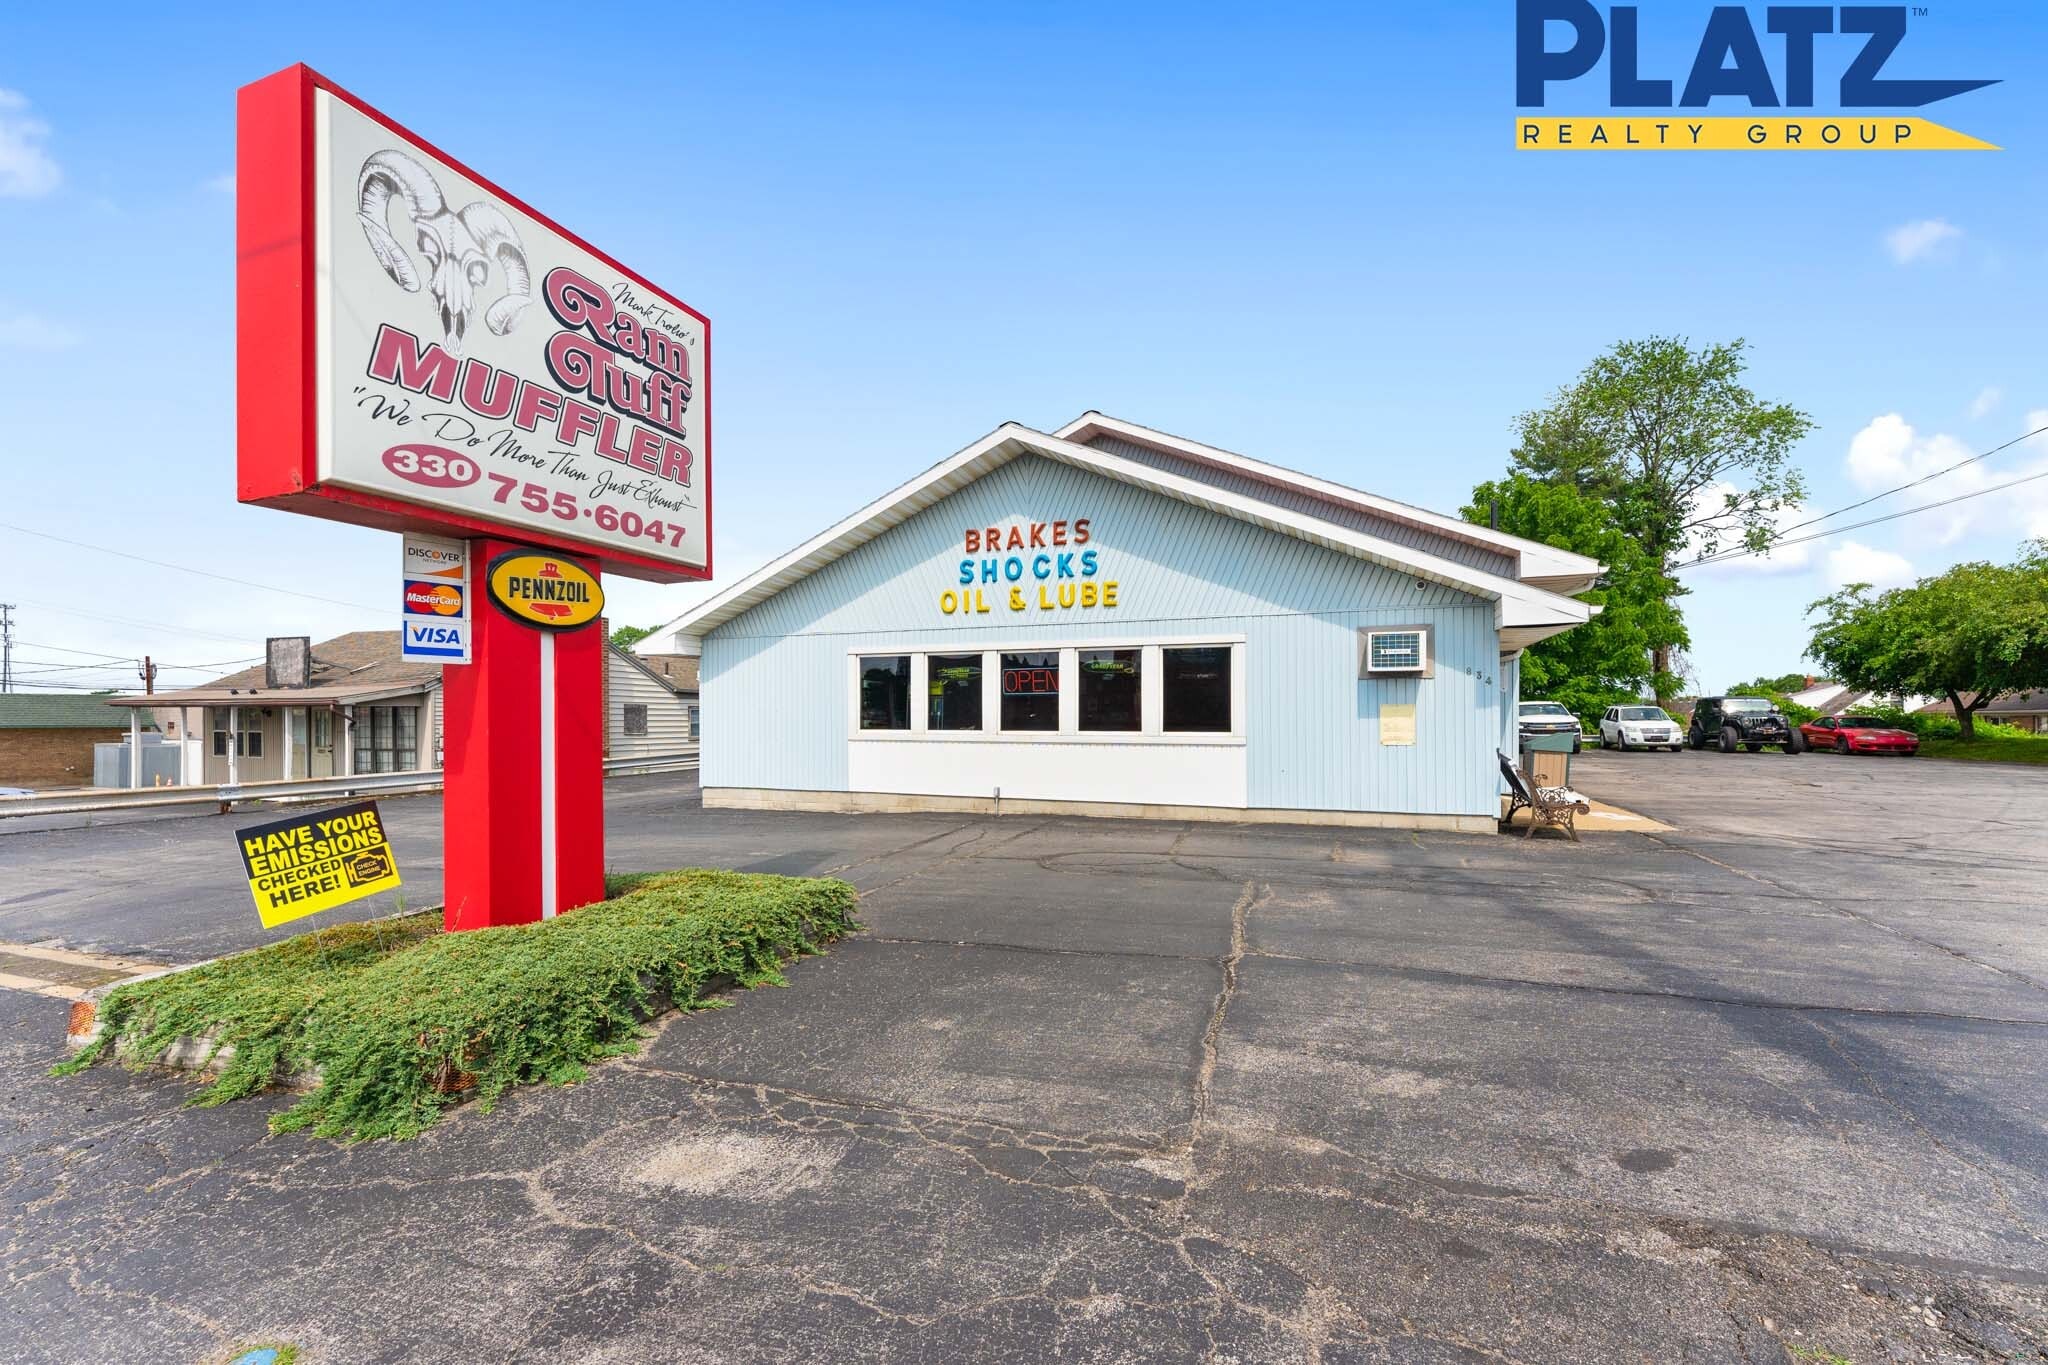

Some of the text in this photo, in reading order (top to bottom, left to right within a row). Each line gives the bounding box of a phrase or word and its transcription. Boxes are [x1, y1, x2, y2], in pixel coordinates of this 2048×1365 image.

[612, 282, 654, 325] Mark
[542, 266, 692, 384] Ram
[544, 330, 692, 440] Tuff
[366, 323, 693, 488] MUFFLER
[392, 450, 473, 482] 330
[421, 413, 485, 447] Do
[487, 429, 548, 469] More
[548, 450, 590, 481] Than
[589, 470, 638, 499] Just
[965, 518, 1091, 553] BRAKES
[408, 547, 460, 562] DISCOVER
[960, 550, 1098, 584] SHOCKS
[407, 592, 460, 606] MasterCard
[508, 576, 590, 602] PENNZOIL
[940, 581, 1119, 614] OIL & LUBE
[411, 626, 461, 645] VISA
[1004, 670, 1059, 693] OPEN
[244, 811, 378, 857] HAVE YOUR
[250, 827, 383, 877] EMISSIONS
[356, 860, 377, 870] CHECK
[258, 859, 341, 891] CHECKED
[270, 875, 341, 908] HERE!
